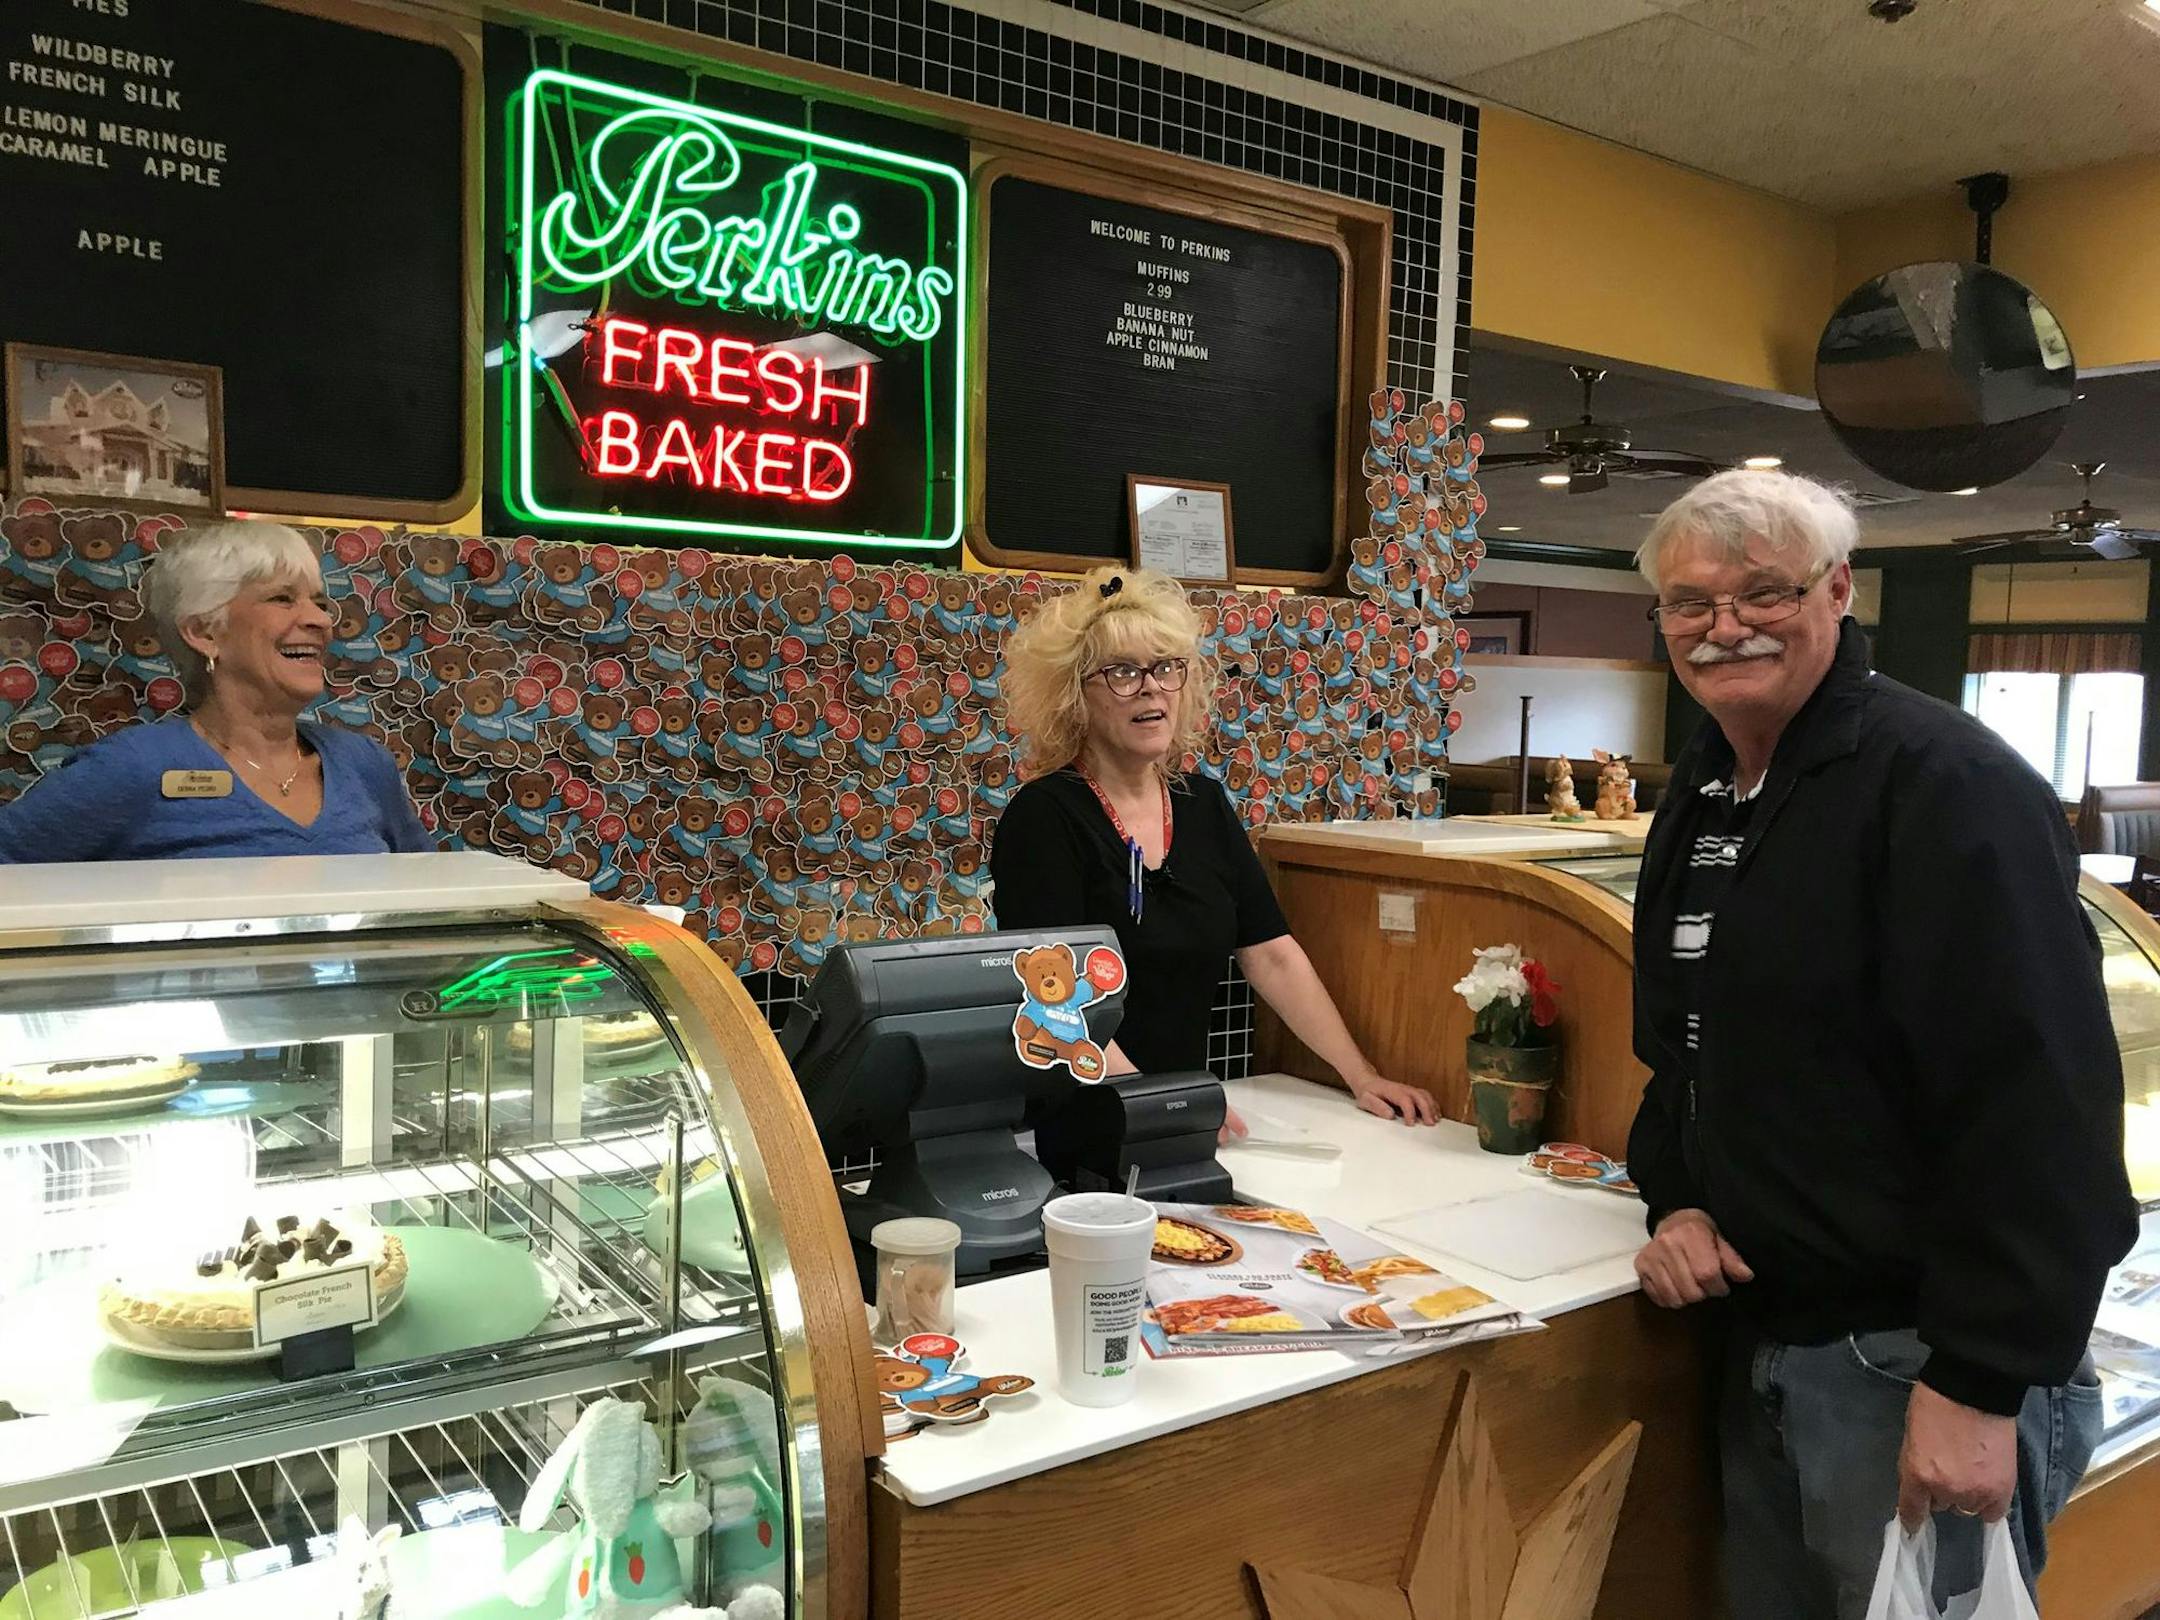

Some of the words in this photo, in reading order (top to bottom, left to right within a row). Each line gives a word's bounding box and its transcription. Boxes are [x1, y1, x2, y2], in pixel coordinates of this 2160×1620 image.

[31, 33, 174, 79] WILDBERRY
[9, 61, 105, 97] FRENCH
[123, 81, 181, 111] SILK
[4, 105, 87, 137] LEMON
[99, 122, 227, 163] MERINGUE
[0, 131, 109, 169] CARAMEL
[143, 156, 221, 187] APPLE
[541, 108, 954, 341] Perkins
[77, 229, 163, 261] APPLE
[1090, 219, 1151, 245] WELCOME
[1160, 234, 1175, 250] TO
[1181, 240, 1231, 262] PERKINS
[1137, 260, 1190, 284] MUFFINS
[1123, 302, 1194, 327] BLUEBERRY
[1117, 317, 1165, 338] BANANA
[1171, 328, 1195, 343] NUT
[1106, 331, 1143, 350] APPLE
[1148, 338, 1208, 360] CINNAMON
[602, 319, 871, 427] FRESH
[1143, 353, 1175, 370] BRAN
[597, 410, 853, 501] BAKED
[981, 957, 1013, 968] micros
[1166, 1100, 1188, 1110] EPSON
[982, 1187, 1019, 1201] micros
[274, 1289, 320, 1304] Chocolate
[321, 1282, 352, 1294] French
[1090, 1292, 1118, 1301] GOOD
